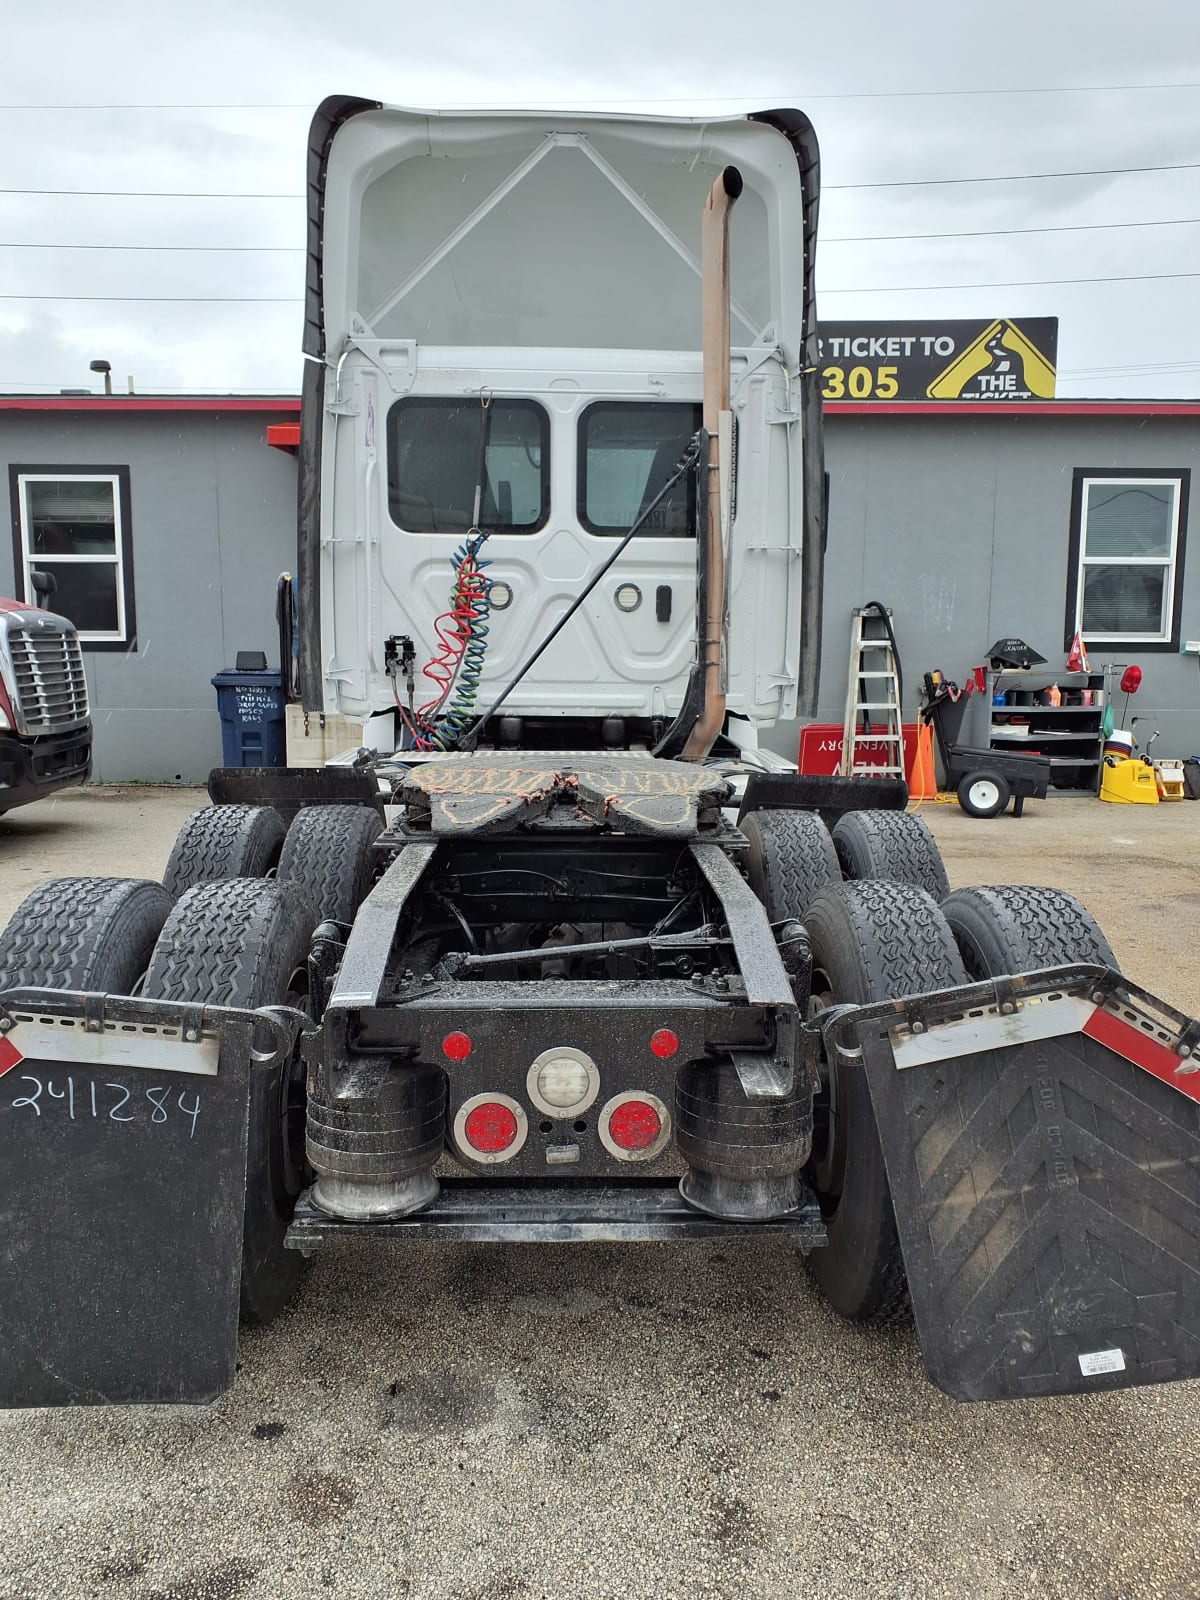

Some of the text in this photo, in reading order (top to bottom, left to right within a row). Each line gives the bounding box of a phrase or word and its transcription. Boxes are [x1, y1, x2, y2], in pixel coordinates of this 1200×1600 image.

[828, 336, 917, 358] TICKET
[919, 336, 956, 357] TO
[821, 366, 899, 399] 305
[977, 374, 1017, 391] THE
[11, 1076, 201, 1139] 241284
